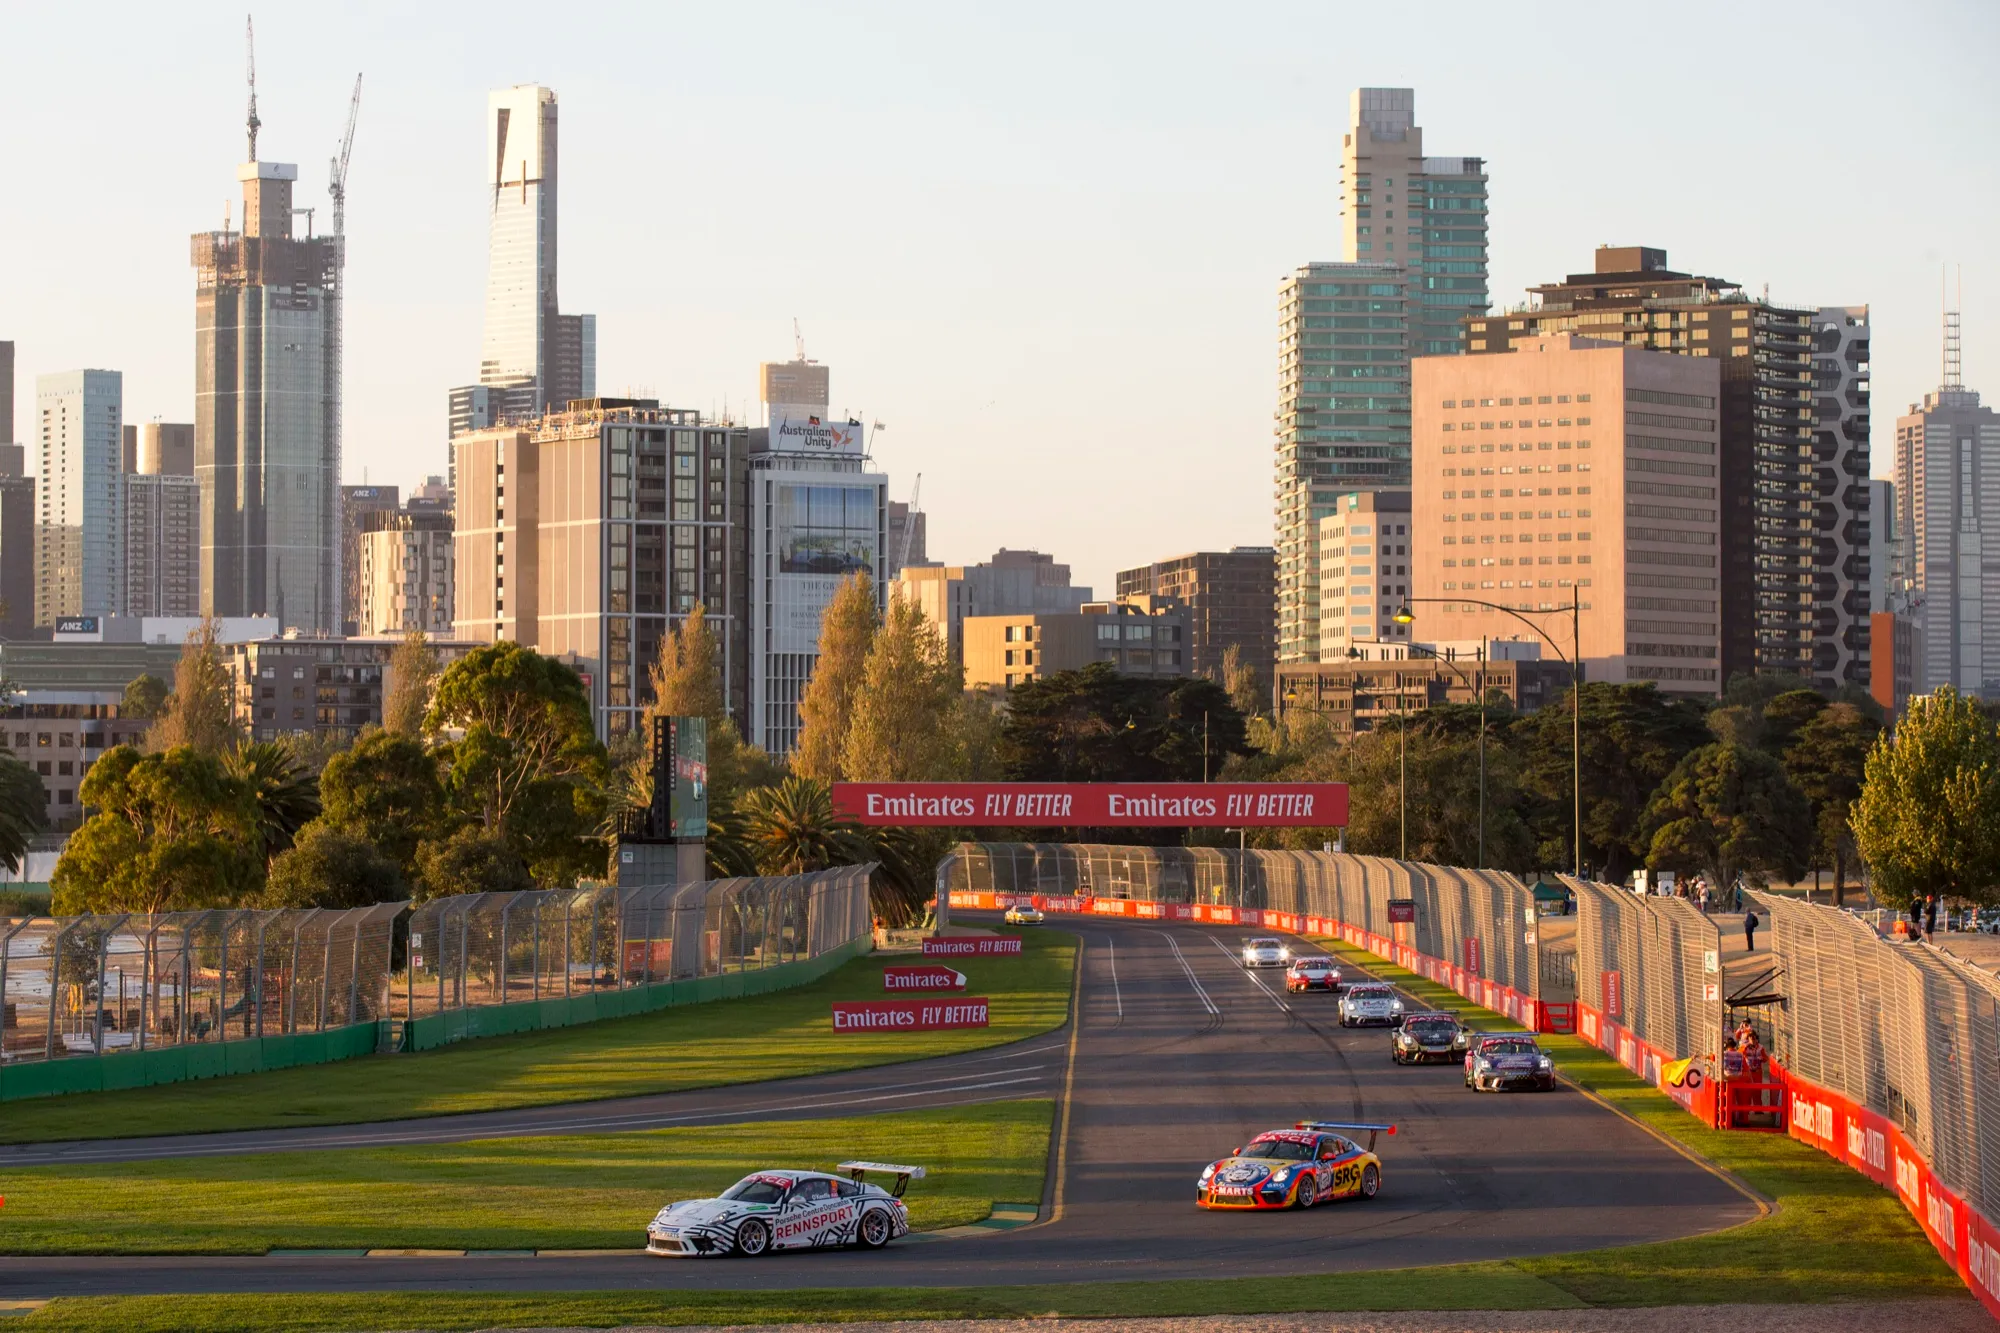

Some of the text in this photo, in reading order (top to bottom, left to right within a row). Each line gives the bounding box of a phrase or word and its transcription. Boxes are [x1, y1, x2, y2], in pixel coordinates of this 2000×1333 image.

[779, 425, 831, 437] Australian
[805, 436, 831, 449] Unity
[60, 622, 82, 631] ANZ
[867, 793, 1072, 816] Emirates FLY BETTER
[1108, 793, 1314, 817] Emirates FLY BETTER
[923, 940, 1021, 954] Emirates FLY BETTER
[885, 972, 950, 988] Emirates
[1706, 985, 1714, 999] F
[833, 1005, 987, 1028] Emirates FLY BETTER
[1255, 1134, 1313, 1145] PAYCE
[745, 1175, 788, 1187] AYCE
[1335, 1164, 1359, 1187] SRG
[1210, 1186, 1253, 1195] T-MARTS
[775, 1200, 849, 1225] Porsche Centre Doncaster
[776, 1205, 853, 1239] RENNSPORT
